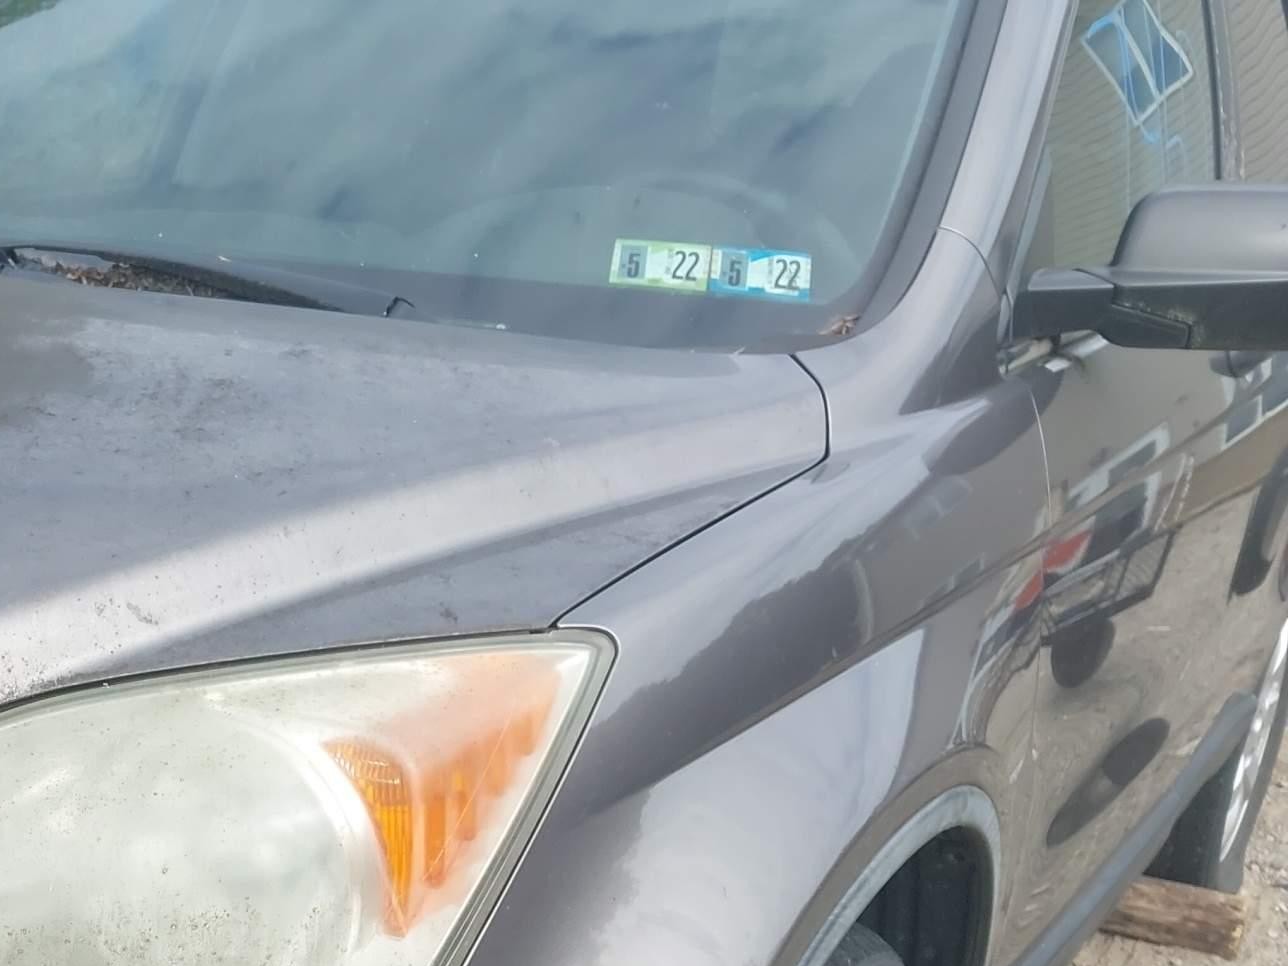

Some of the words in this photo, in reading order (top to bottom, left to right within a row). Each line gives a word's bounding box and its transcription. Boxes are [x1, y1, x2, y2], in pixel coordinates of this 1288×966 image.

[626, 252, 641, 278] 5
[671, 250, 700, 281] 22
[727, 259, 742, 287] 5
[774, 258, 801, 289] 22
